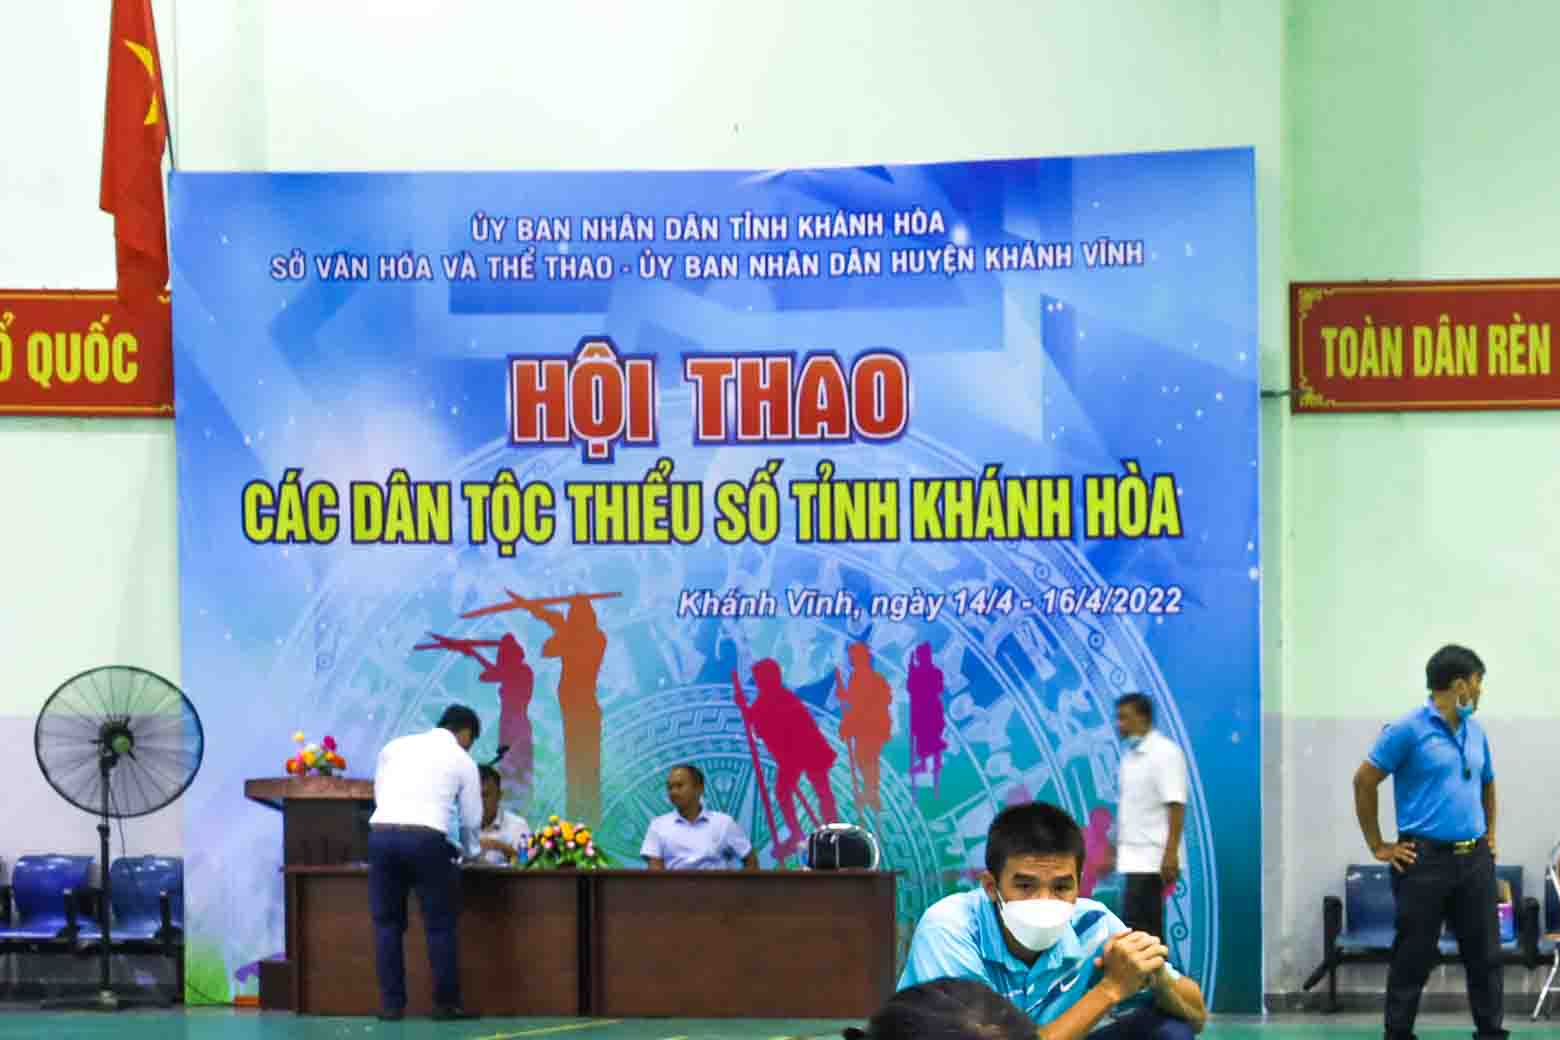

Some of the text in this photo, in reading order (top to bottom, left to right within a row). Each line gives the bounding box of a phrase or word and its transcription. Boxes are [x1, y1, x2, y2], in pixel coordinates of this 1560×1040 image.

[472, 207, 945, 241] ỦY BAN NHÂN DÂN TỈNH KHÁNH HÒA
[271, 247, 305, 280] SỞ
[379, 252, 432, 280] HÓA
[443, 251, 479, 280] VÀ
[487, 246, 537, 280] THỂ
[544, 255, 612, 280] THAO
[639, 249, 679, 279] ỦY
[685, 254, 738, 279] BAN
[749, 250, 819, 278] NHÂN
[829, 249, 881, 276] DÂN
[891, 246, 975, 279] HUYỆN
[984, 241, 1073, 272] KHÁNH
[1083, 238, 1146, 267] VĨNH
[27, 313, 139, 389] QUỐC
[1321, 316, 1403, 377] TOÀN
[1413, 314, 1478, 376] DÂN
[1488, 313, 1551, 375] RÈN
[509, 338, 911, 463] HỘI THAO
[242, 458, 1183, 557] CÁC DÂN TỘC THIỂU SỐ TỈNH KHÁNH HÒA
[678, 587, 776, 618] Khánh
[787, 586, 862, 621] Vĩnh,
[872, 590, 945, 622] ngày
[951, 586, 1013, 615] 14/4
[1042, 585, 1184, 615] 16/4/2022
